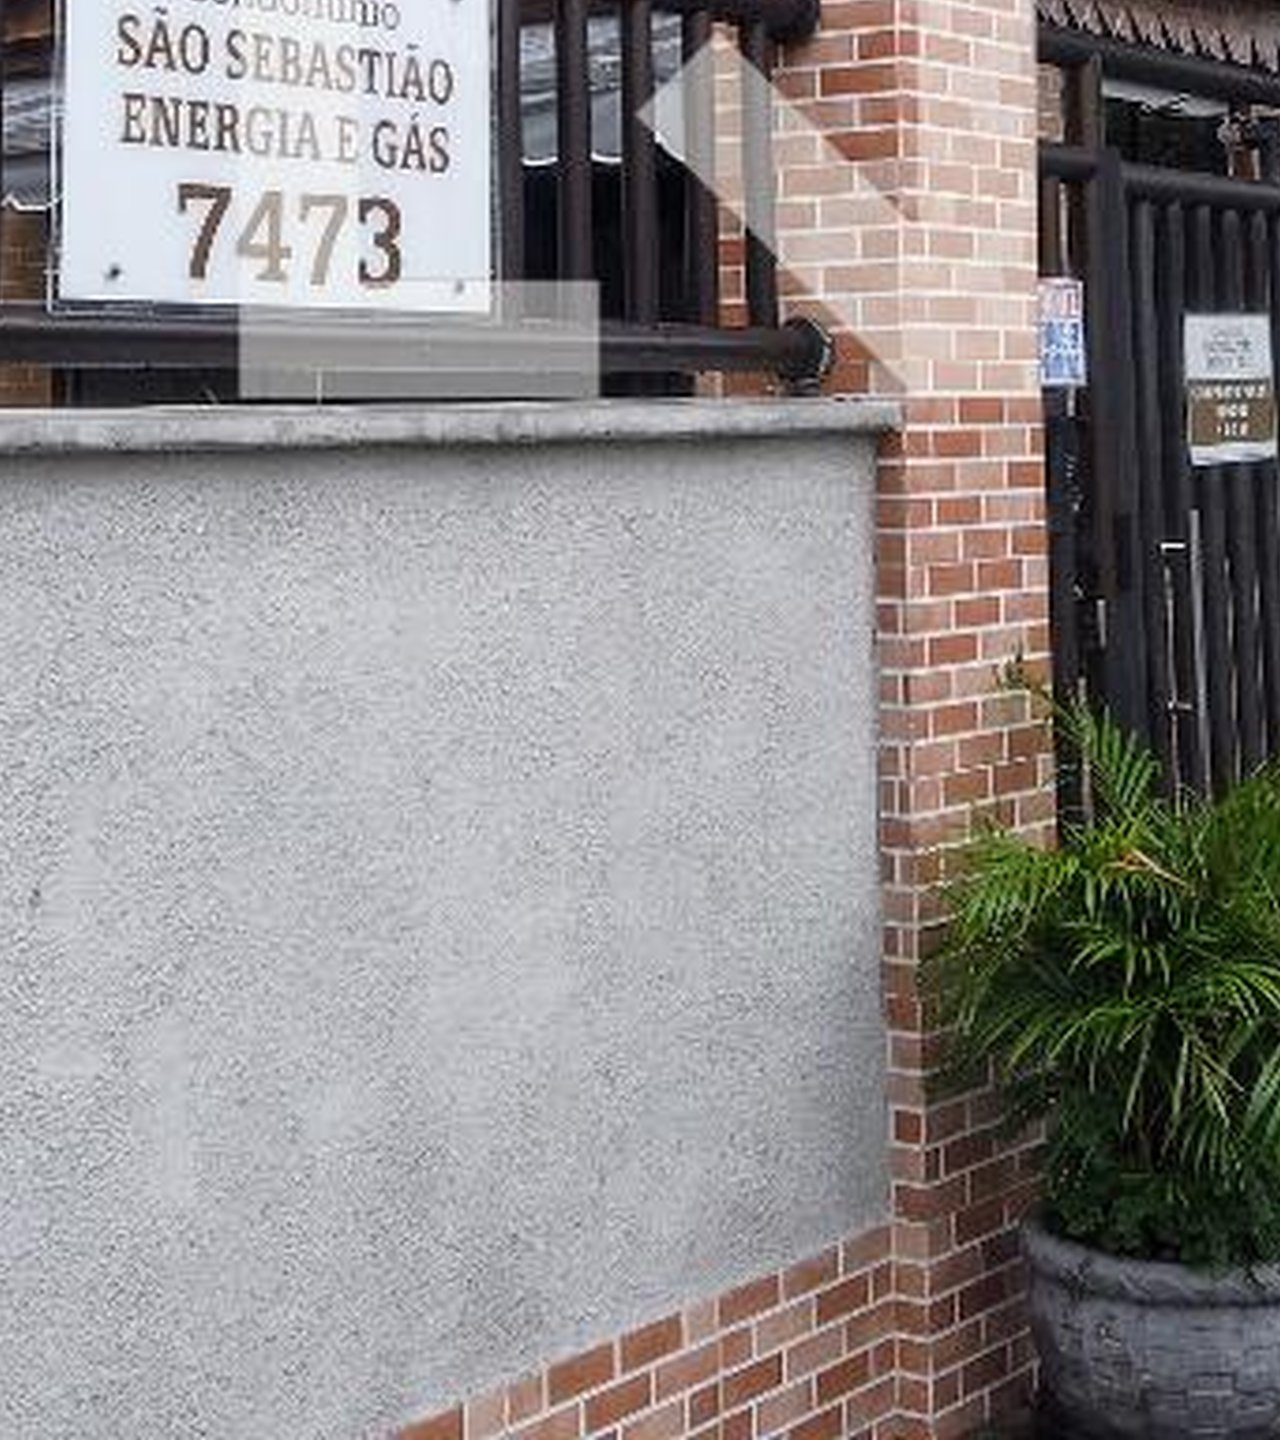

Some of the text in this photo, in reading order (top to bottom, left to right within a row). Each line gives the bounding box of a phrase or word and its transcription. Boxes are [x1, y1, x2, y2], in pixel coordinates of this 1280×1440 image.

[117, 7, 454, 106] SÃO SEBASTIÃO
[120, 93, 451, 174] ENERGIA E GÁS
[177, 182, 403, 290] 7473
